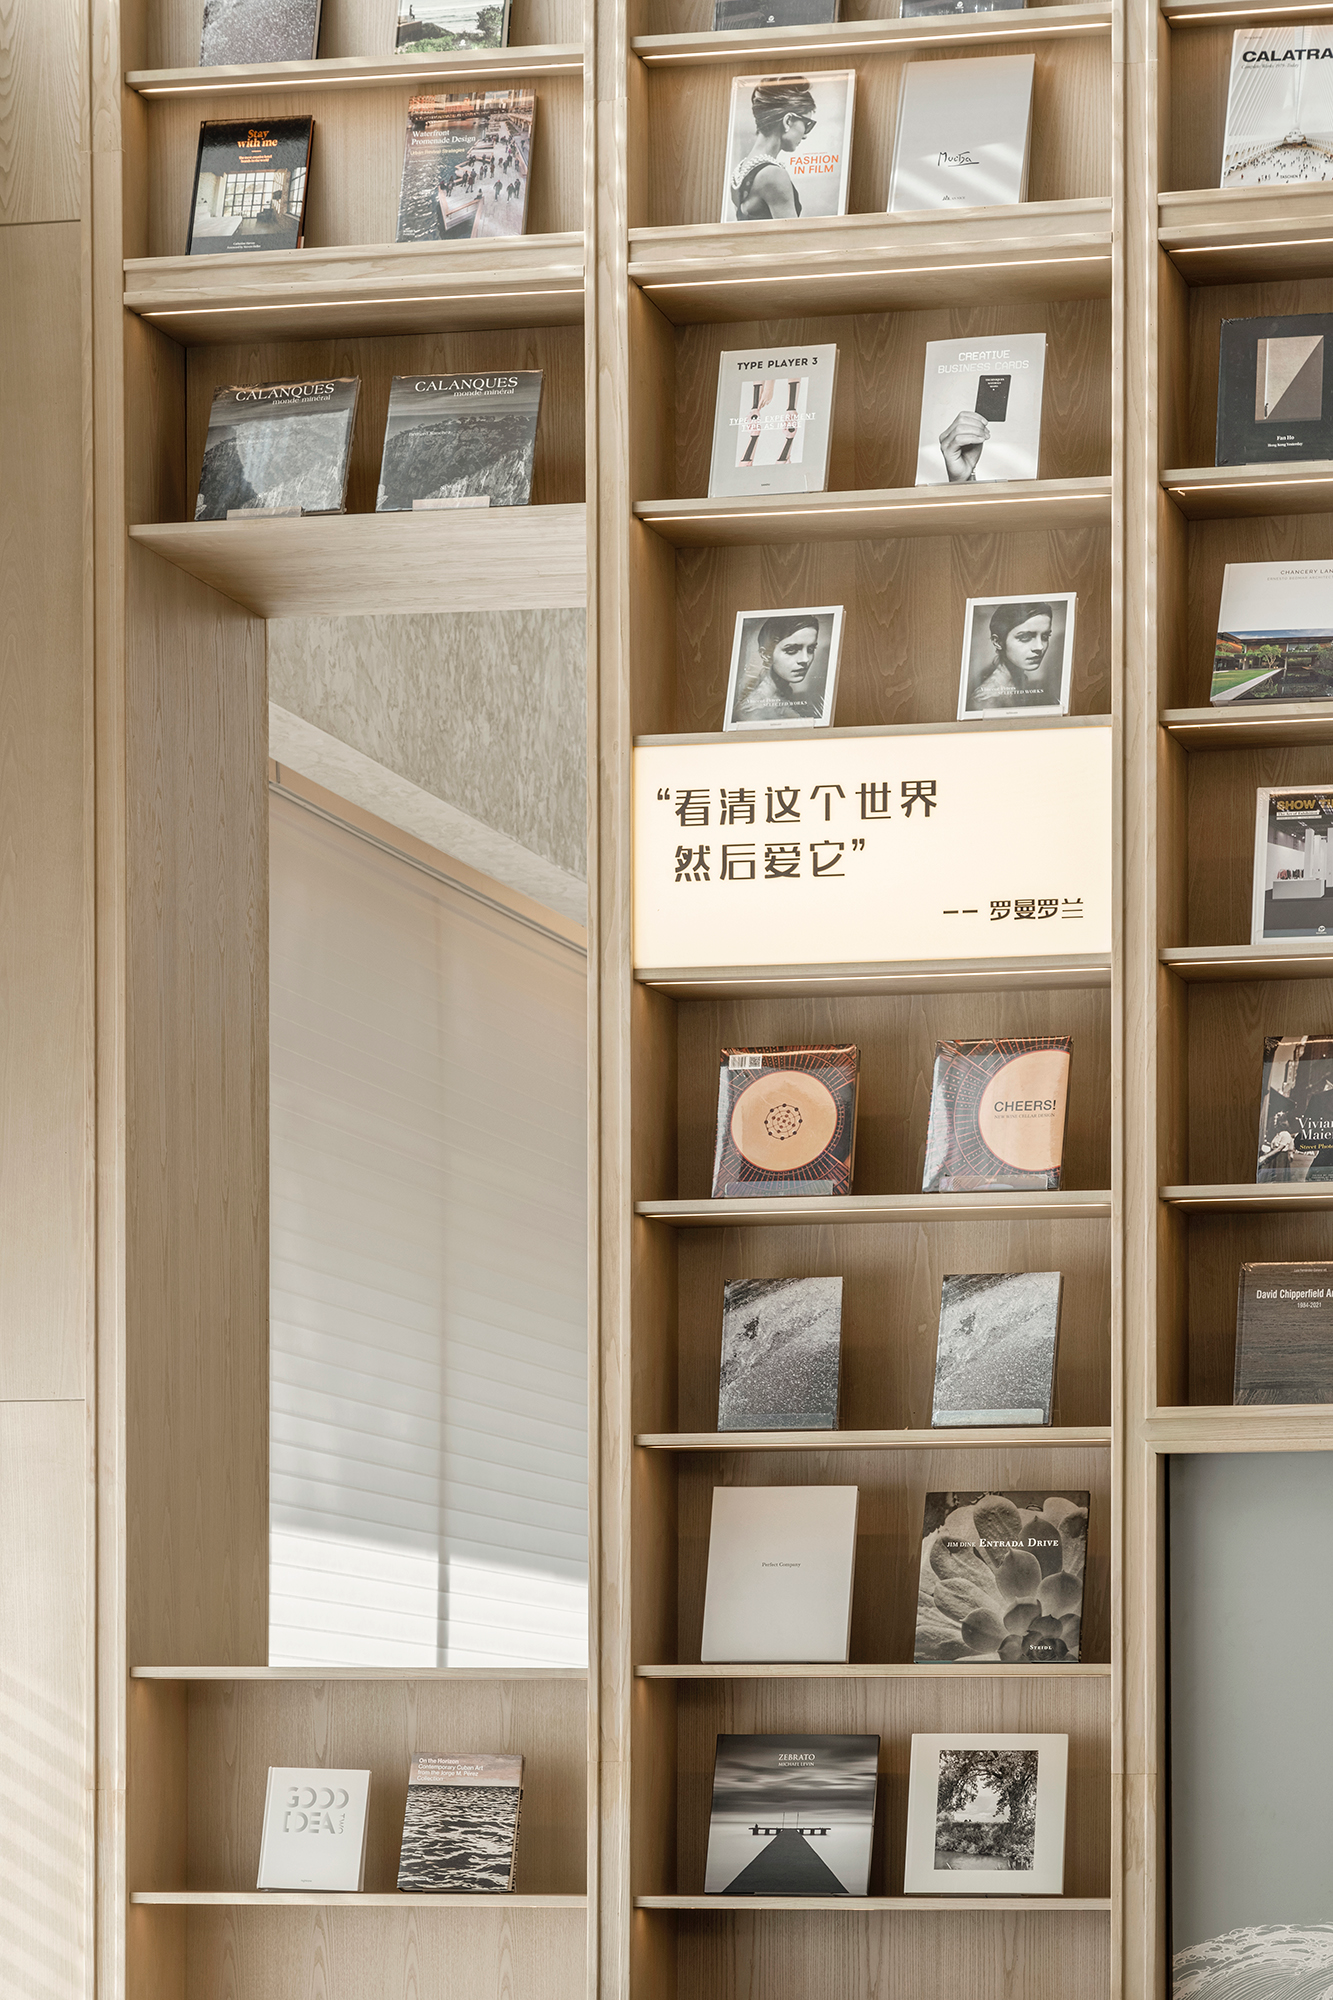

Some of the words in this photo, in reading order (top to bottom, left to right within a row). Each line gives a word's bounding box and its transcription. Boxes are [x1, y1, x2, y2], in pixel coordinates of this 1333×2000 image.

[1242, 47, 1333, 63] CALATRA
[248, 129, 270, 140] Stay
[411, 137, 450, 145] Promenade
[451, 135, 476, 143] Design
[237, 138, 260, 148] with
[261, 139, 278, 147] me
[790, 154, 839, 166] FASHION
[794, 166, 805, 175] IN
[808, 164, 834, 174] FILM
[958, 349, 1011, 361] CREATIVE
[737, 361, 763, 370] TYPE
[767, 358, 808, 368] PLAYER
[812, 356, 819, 365] 3
[937, 362, 991, 374] BUSINESS
[994, 360, 1030, 370] CARDS
[414, 376, 518, 392] CALANQUES
[235, 383, 335, 402] CALANQUES
[483, 387, 515, 395] minéral
[272, 397, 300, 405] monde
[301, 394, 331, 403] minéral
[656, 780, 938, 827] “看清这个世界
[1277, 800, 1316, 810] SHOW
[674, 838, 866, 882] 然后爱它”
[990, 898, 1084, 921] 罗曼罗兰
[994, 1099, 1056, 1112] CHEERS!
[1256, 1289, 1278, 1299] David
[1279, 1288, 1325, 1300] Chipperfield
[778, 1753, 816, 1761] ZEBRATO
[417, 1763, 456, 1771] Contemporary
[286, 1786, 350, 1810] GOOD
[282, 1810, 336, 1834] IDEA
